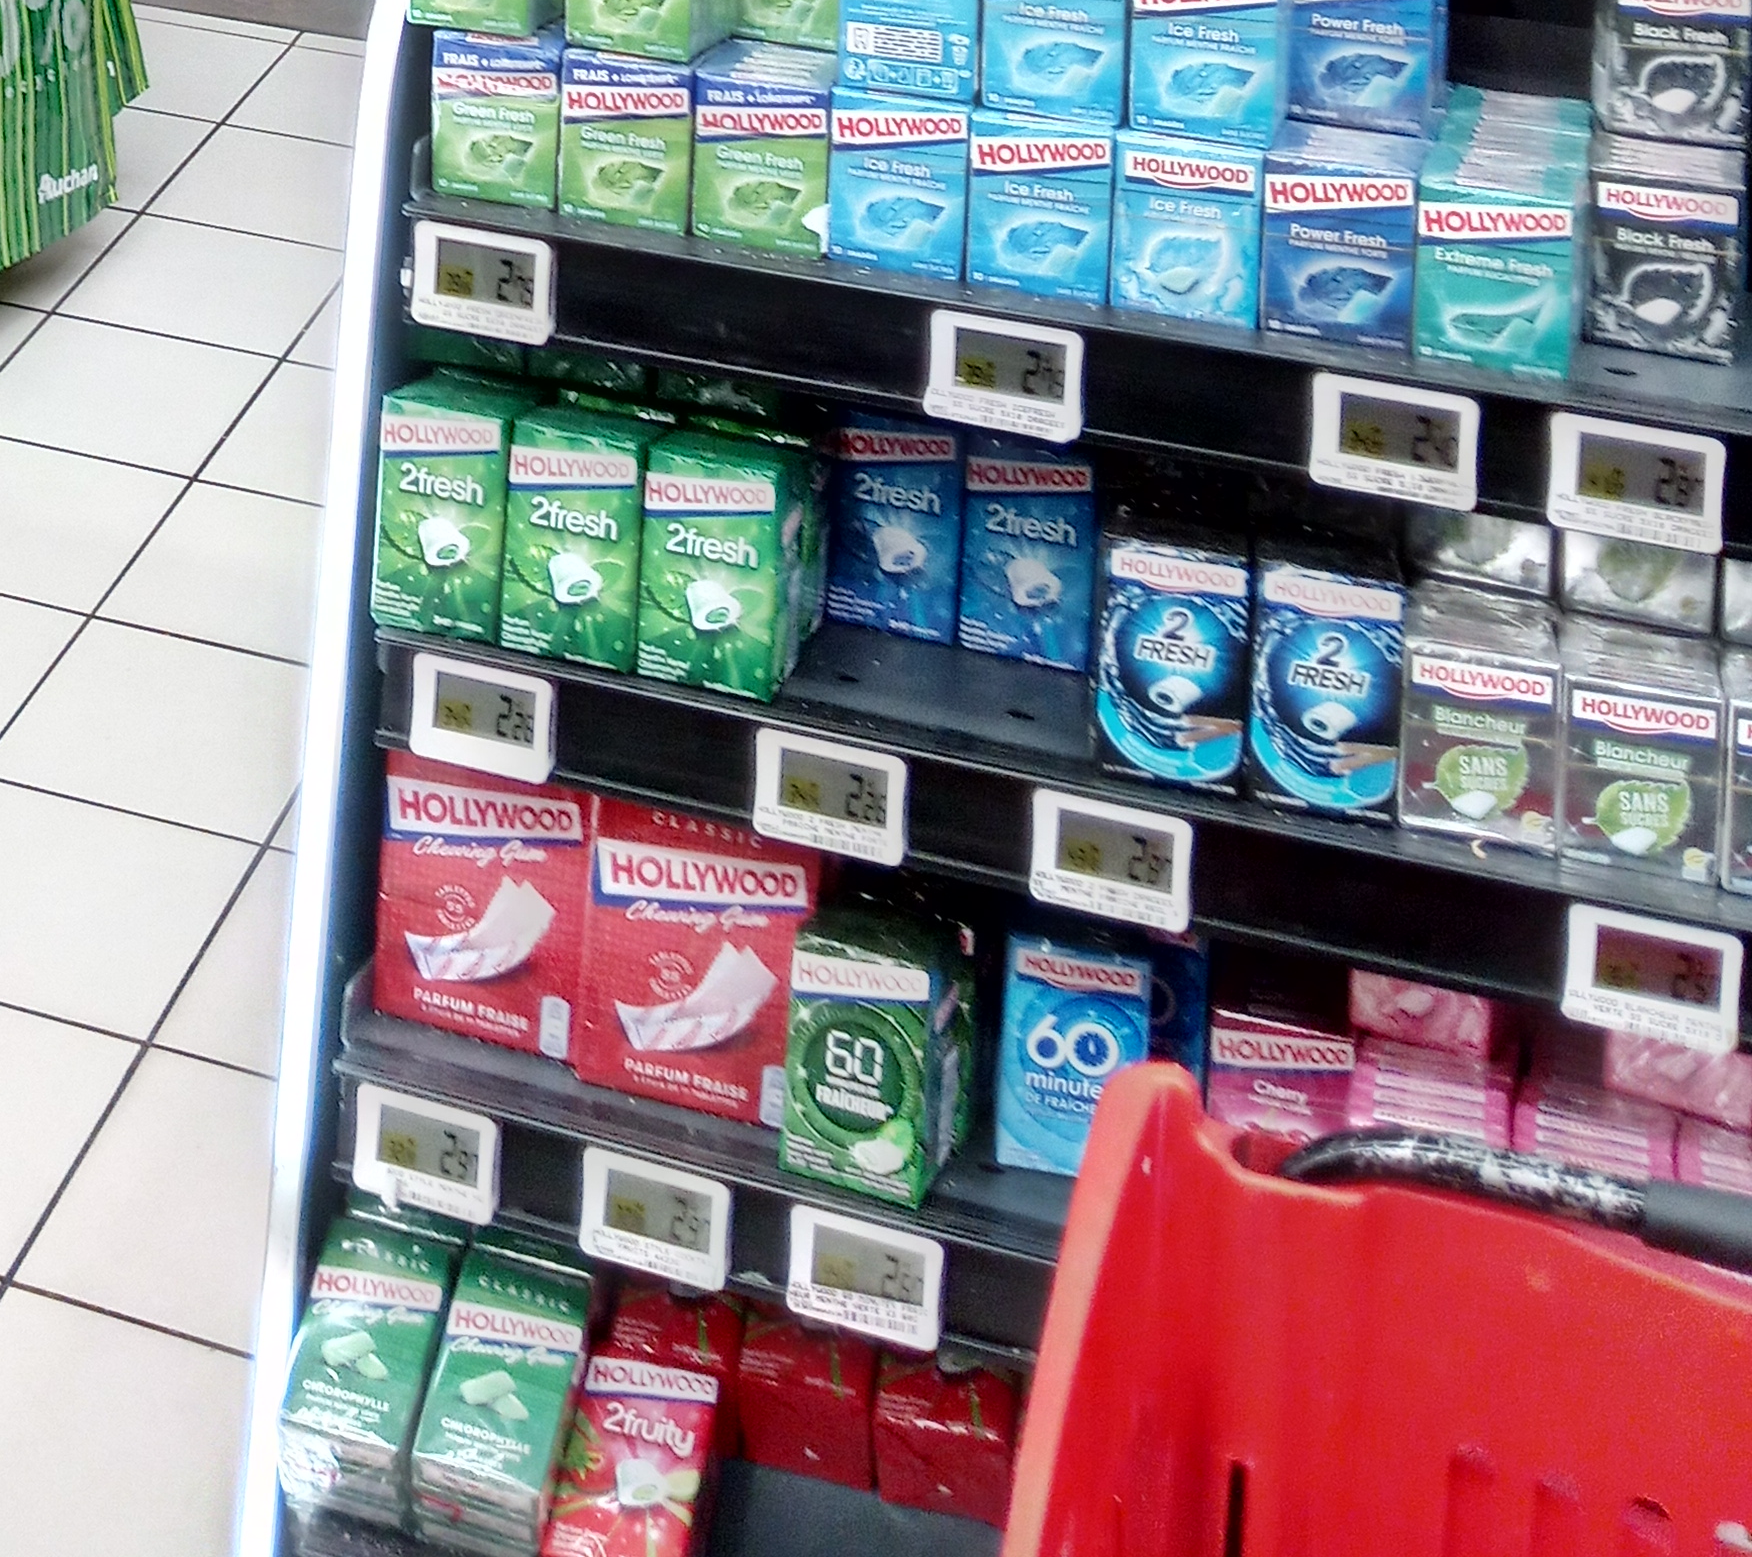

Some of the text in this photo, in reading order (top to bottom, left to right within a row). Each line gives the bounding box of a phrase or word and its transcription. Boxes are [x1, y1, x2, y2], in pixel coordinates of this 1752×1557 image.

[1047, 6, 1089, 22] Fresh
[1311, 13, 1404, 36] Power Fresh
[1199, 25, 1239, 42] Fresh
[1633, 23, 1727, 45] Black Fresh
[443, 53, 478, 68] FRAIS
[567, 90, 685, 112] HOLLYWOOD
[702, 111, 823, 131] HOLLYWOOD
[837, 116, 963, 138] HOLLYWOOD
[977, 142, 1108, 165] HOLLYWOOD
[37, 164, 100, 204] Auchan
[890, 161, 931, 178] Fresh
[1132, 156, 1250, 184] HOLLYWOOD
[1033, 185, 1074, 202] Fresh
[1270, 180, 1409, 204] HOLLYWOOD
[1605, 187, 1728, 217] HOLLYWOOD
[1181, 202, 1222, 219] Fresh
[1424, 207, 1567, 233] HOLLYWOOD
[1290, 224, 1387, 248] Power Fresh
[1616, 228, 1714, 253] Black Fresh
[1434, 246, 1554, 278] Extreme Fresh
[383, 422, 493, 445] HOLLYWOOD
[839, 432, 950, 457] HOLLYWOOD
[514, 453, 630, 478] HOLLYWOOD
[968, 461, 1088, 487] HOLLYWOOD
[399, 461, 485, 508] 2fresh
[648, 479, 767, 505] HOLLYWOOD
[853, 472, 942, 516] 2fresh
[530, 495, 618, 541] 2fresh
[984, 503, 1078, 547] 2fresh
[665, 522, 759, 570] 2fresh
[1119, 556, 1238, 588] HOLLYWOOD
[1273, 581, 1393, 613] HOLLYWOOD
[1163, 606, 1192, 641] 2
[1135, 636, 1217, 670] FRESH
[1316, 633, 1346, 667] 2
[1290, 660, 1370, 697] FRESH
[1419, 662, 1546, 697] HOLLYWOOD
[1435, 705, 1526, 735] Blancheur
[1581, 696, 1711, 731] HOLLYWOOD
[1458, 754, 1509, 777] SANS
[1595, 740, 1689, 769] Blancheur
[398, 788, 573, 832] HOLLYWOOD
[1619, 790, 1669, 814] SANS
[651, 811, 763, 849] CLASSIC
[413, 835, 499, 867] Chewing
[611, 853, 797, 898] HOLLYWOOD
[625, 900, 714, 931] Chewing
[798, 962, 926, 994] HOLLYWOOD
[1025, 957, 1134, 987] HOLLYWOOD
[412, 986, 529, 1032] PARFUM FRAISE
[825, 1030, 884, 1086] 60
[1026, 1014, 1120, 1077] 60
[1217, 1037, 1348, 1066] HOLLYWOOD
[623, 1056, 749, 1101] PARFUM FRAISE
[1025, 1072, 1102, 1097] minute
[1252, 1078, 1308, 1104] Cherry
[316, 1272, 435, 1305] HOLLYWOOD
[478, 1274, 570, 1314] CLASSIC
[455, 1308, 574, 1344] HOLLYWOOD
[592, 1360, 717, 1396] HOLLYWOOD
[601, 1401, 698, 1456] 2fruity
